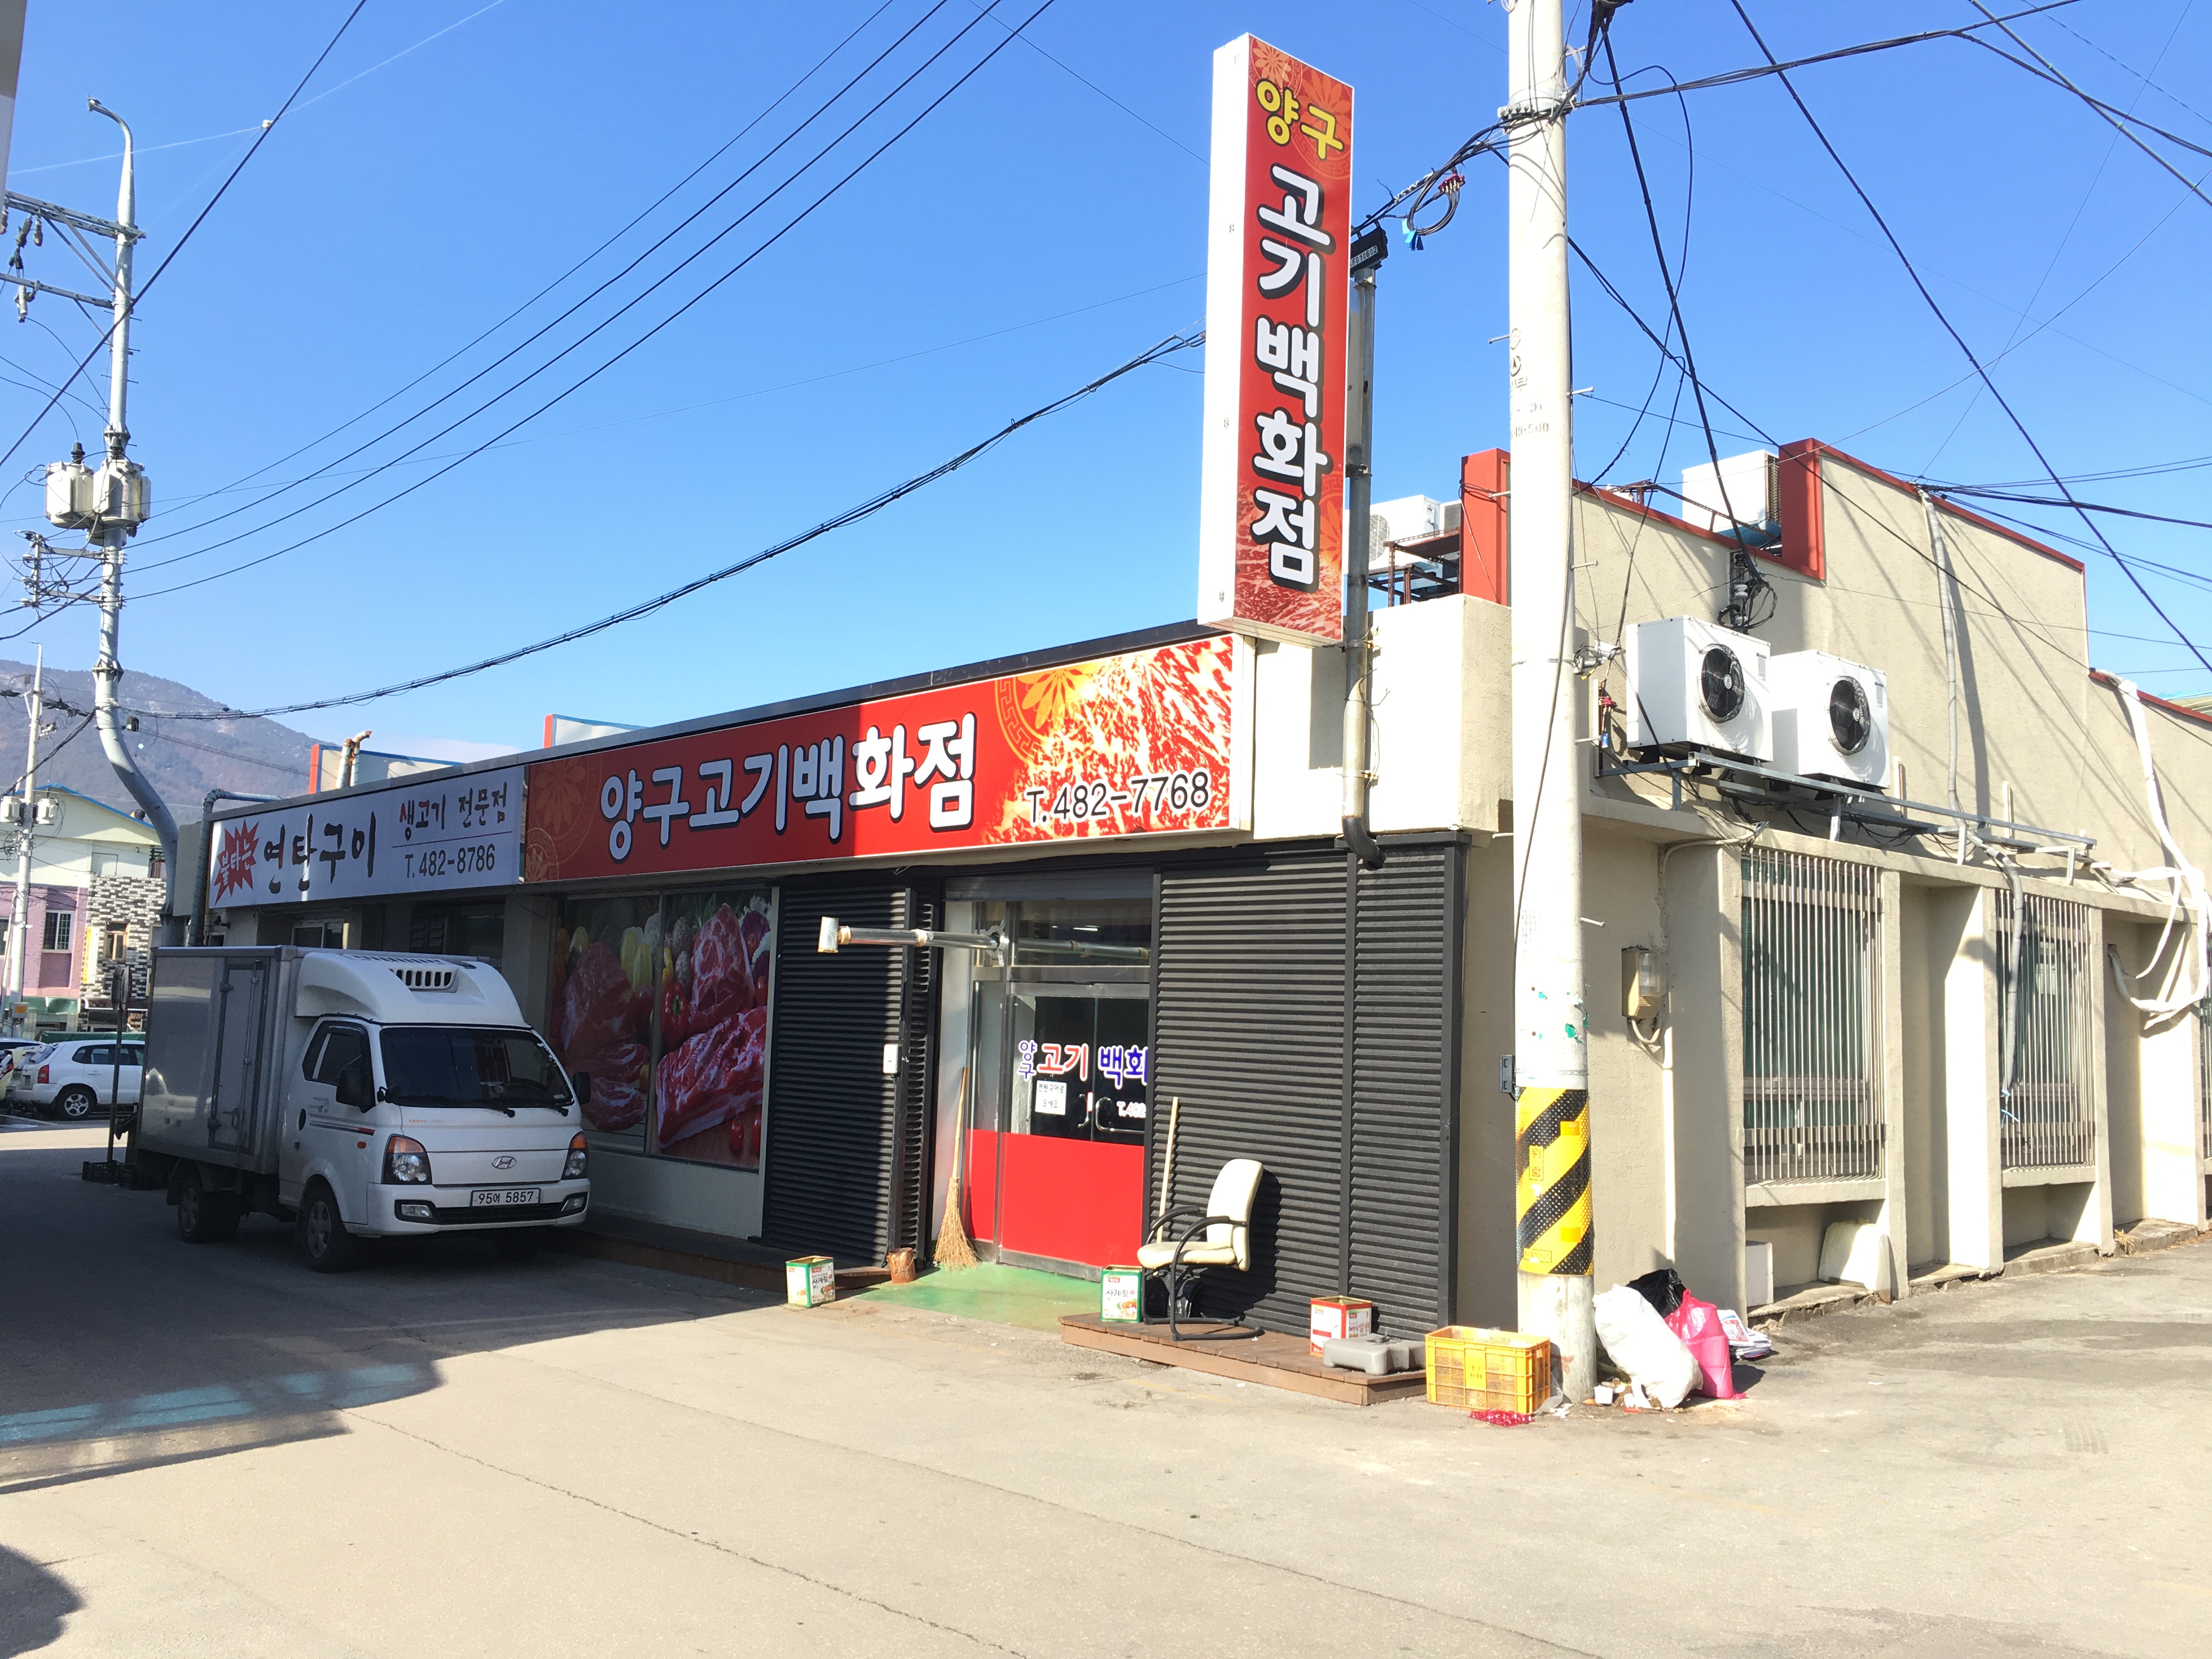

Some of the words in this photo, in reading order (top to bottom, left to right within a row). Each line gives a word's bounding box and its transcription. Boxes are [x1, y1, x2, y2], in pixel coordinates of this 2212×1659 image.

[1256, 78, 1344, 161] 양구
[1251, 163, 1335, 592] 고기백화점
[399, 794, 445, 841] 생고기
[459, 781, 507, 828] 전문점
[601, 713, 976, 864] 양구고기백화점
[1026, 771, 1210, 824] T.482-7768
[221, 838, 252, 885] 불타는
[264, 811, 376, 894] 연탄구이
[405, 844, 495, 878] T.482-8786
[1018, 1040, 1037, 1081] 양구
[478, 1193, 500, 1205] 95어
[505, 1191, 534, 1203] 5857
